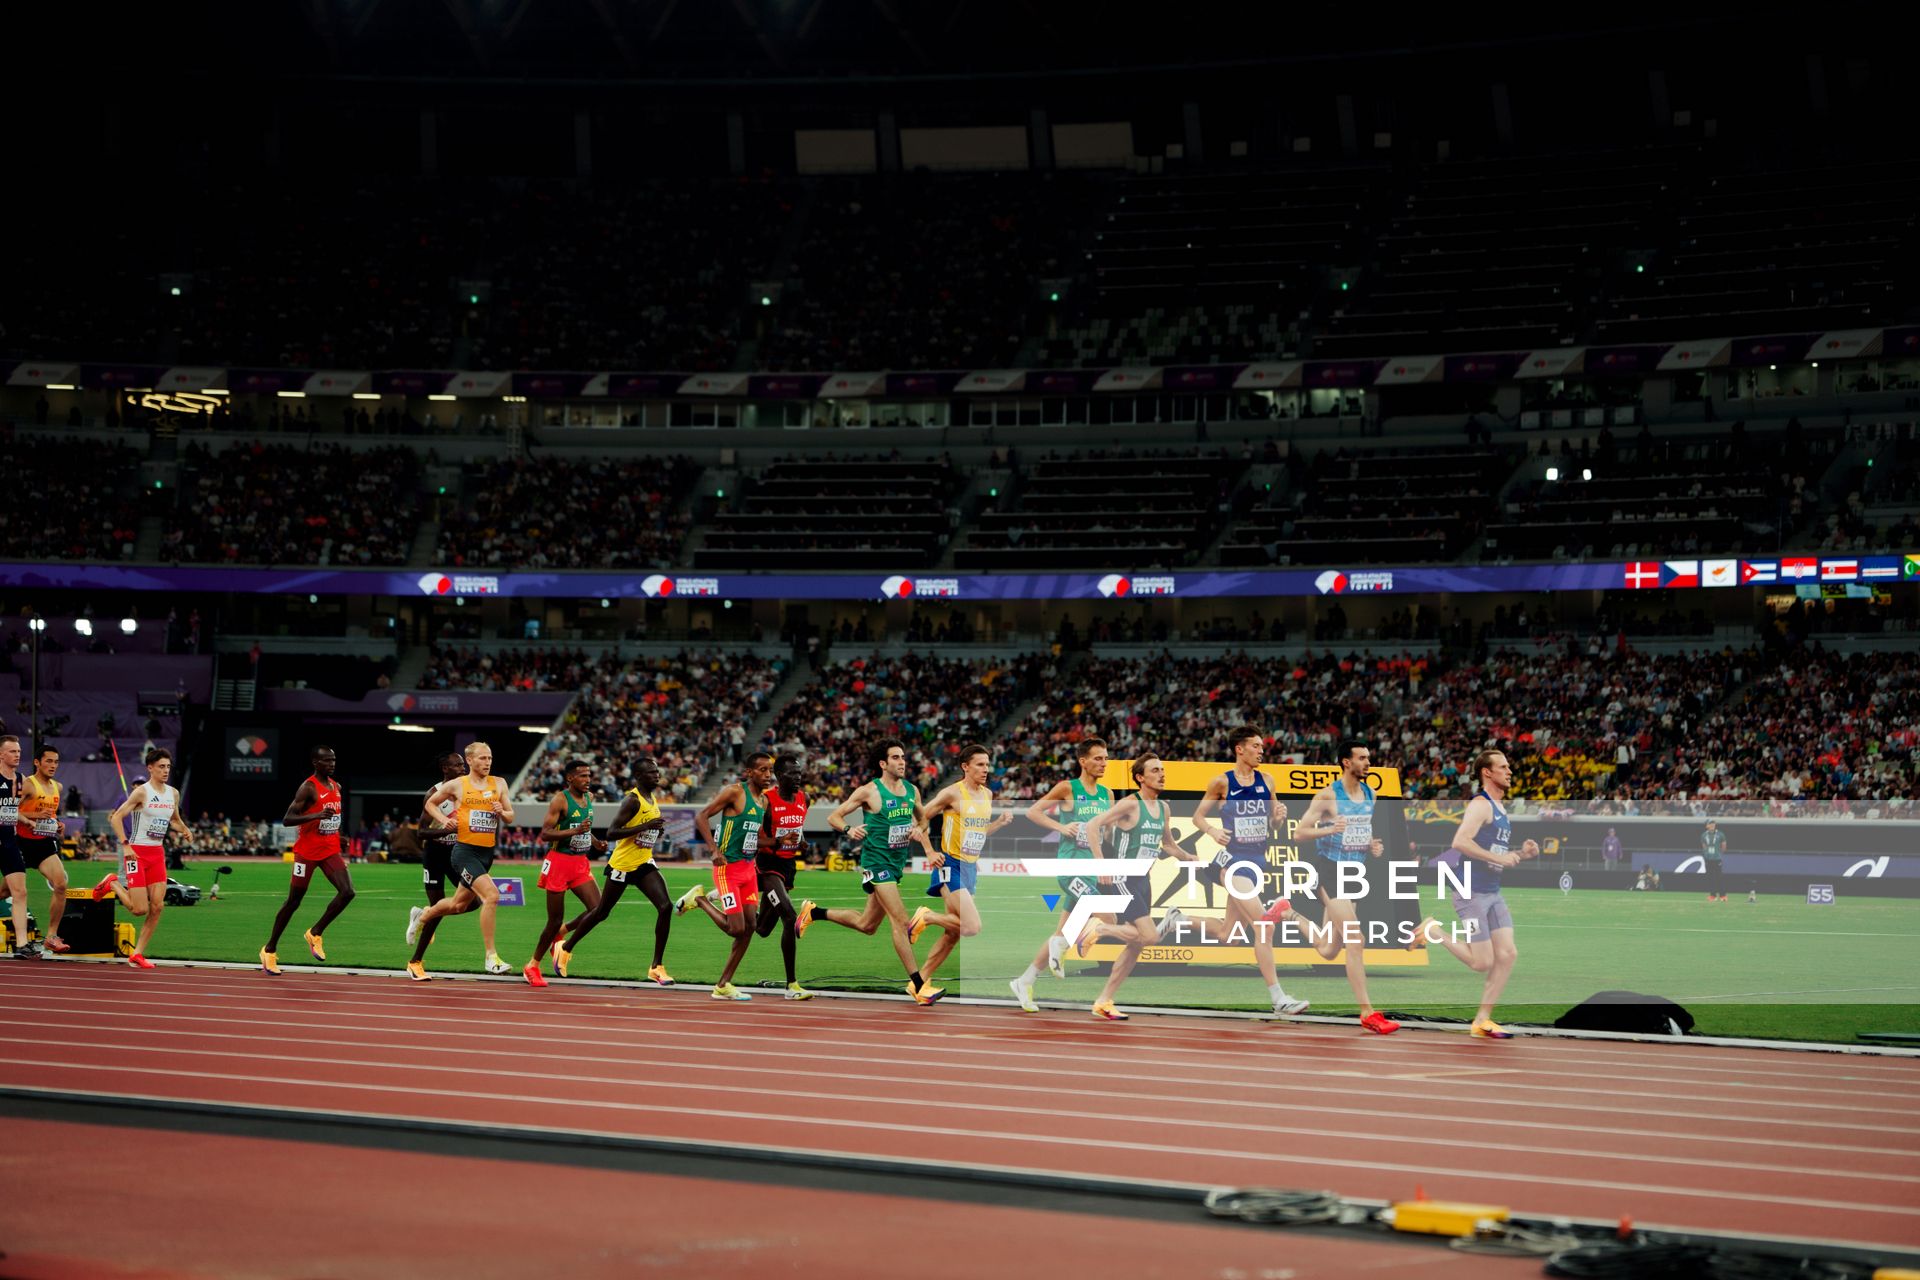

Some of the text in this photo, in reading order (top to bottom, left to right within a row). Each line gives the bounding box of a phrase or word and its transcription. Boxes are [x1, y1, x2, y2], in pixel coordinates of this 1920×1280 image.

[1289, 770, 1383, 791] SEIO
[1235, 799, 1266, 815] USA
[780, 815, 804, 825] SUISSE
[1246, 818, 1265, 826] TDK
[1236, 827, 1266, 836] YOUNG
[127, 862, 137, 872] 15
[297, 865, 302, 875] 3
[543, 862, 549, 872] 7
[615, 871, 623, 880] 2
[1071, 880, 1084, 893] 14
[1810, 888, 1833, 902] 55
[723, 896, 734, 908] 12
[1141, 948, 1194, 961] SEIKO
